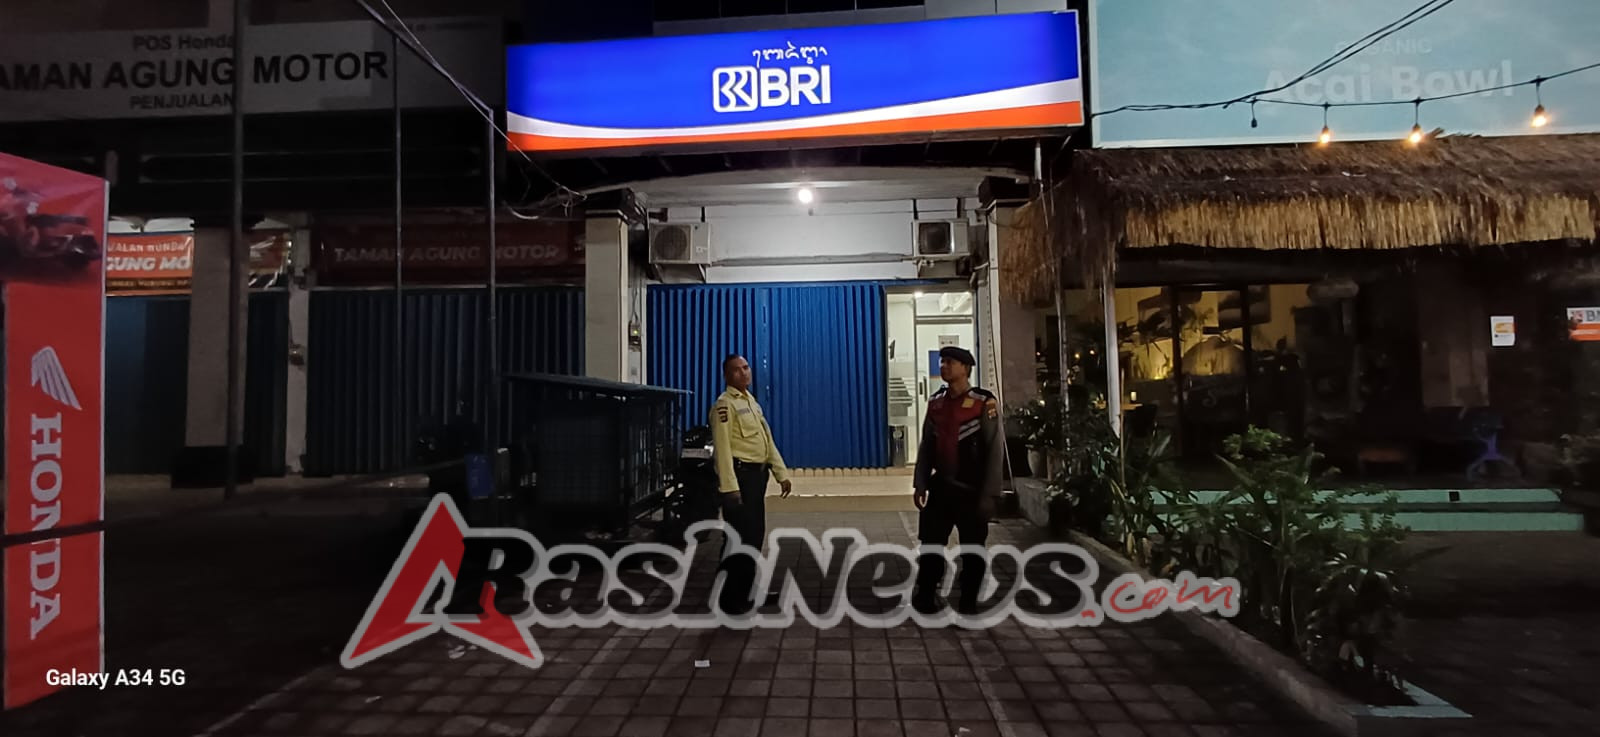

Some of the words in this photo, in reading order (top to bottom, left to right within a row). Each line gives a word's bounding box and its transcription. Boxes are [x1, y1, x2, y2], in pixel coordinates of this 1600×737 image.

[133, 35, 171, 50] POS
[179, 34, 234, 49] Honda
[103, 58, 235, 88] AGUNG
[252, 51, 389, 83] MOTOR
[760, 65, 831, 107] BRI
[1391, 58, 1513, 101] Bowl
[130, 93, 234, 110] PENJUALAN
[410, 246, 481, 261] AGUNG
[30, 412, 63, 639] HONDA
